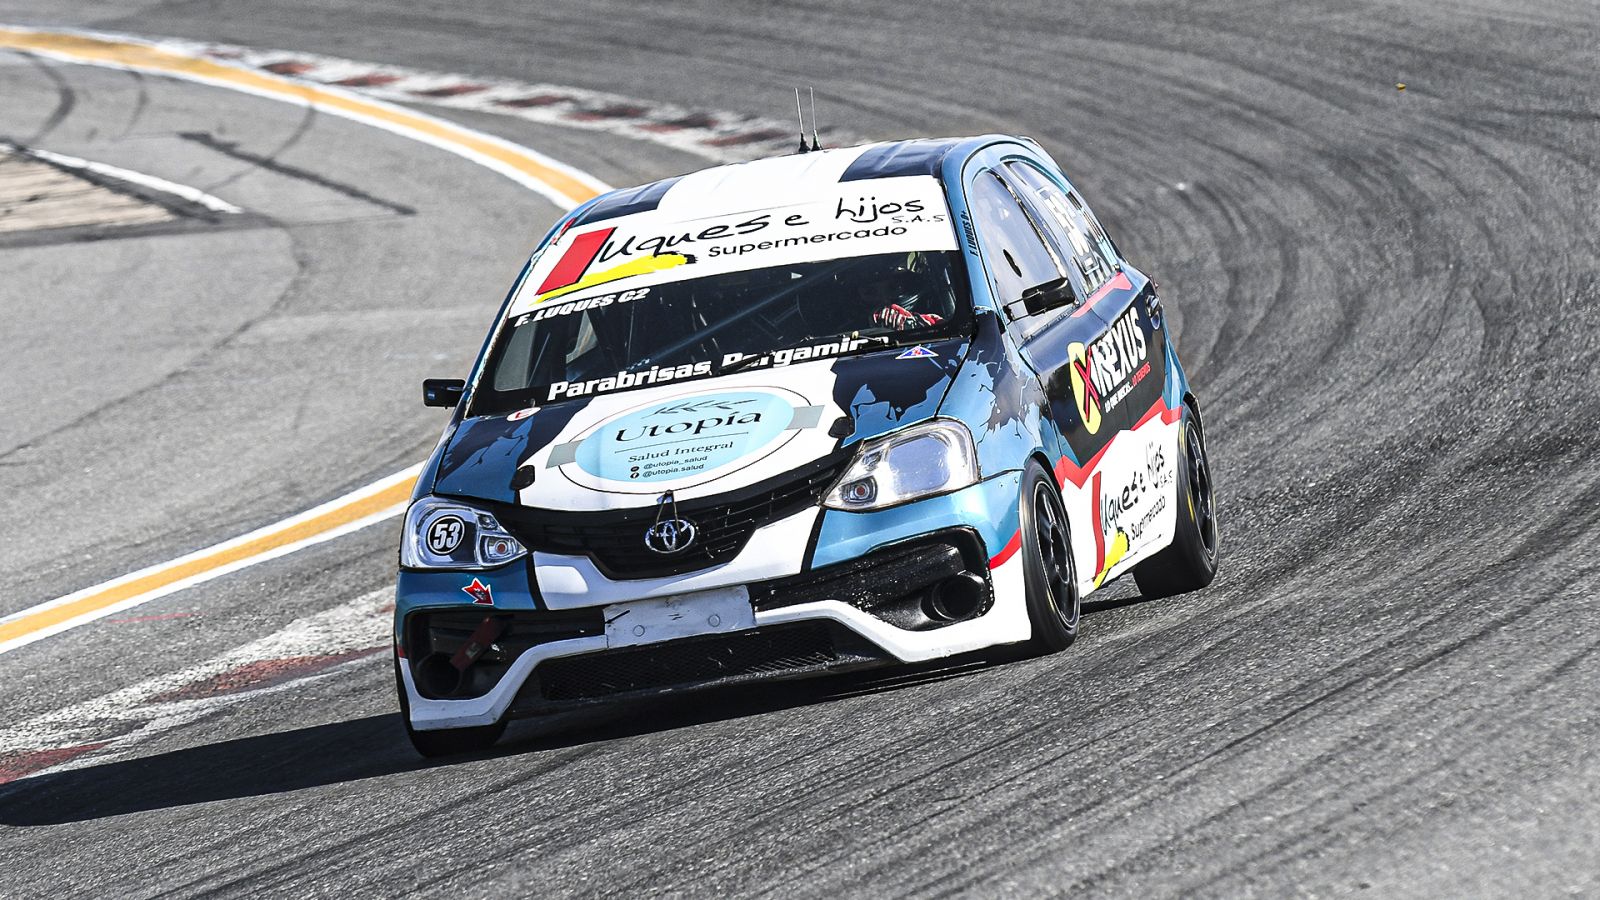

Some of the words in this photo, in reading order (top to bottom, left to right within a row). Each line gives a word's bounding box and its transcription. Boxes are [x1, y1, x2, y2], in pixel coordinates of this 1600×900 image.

[784, 213, 809, 226] e
[835, 197, 925, 223] hijos
[532, 294, 617, 322] LUQUES
[547, 360, 712, 401] Parabrisas
[615, 411, 762, 442] Utopía
[628, 449, 670, 463] Salud
[673, 441, 734, 455] Integral
[433, 522, 461, 550] 53
